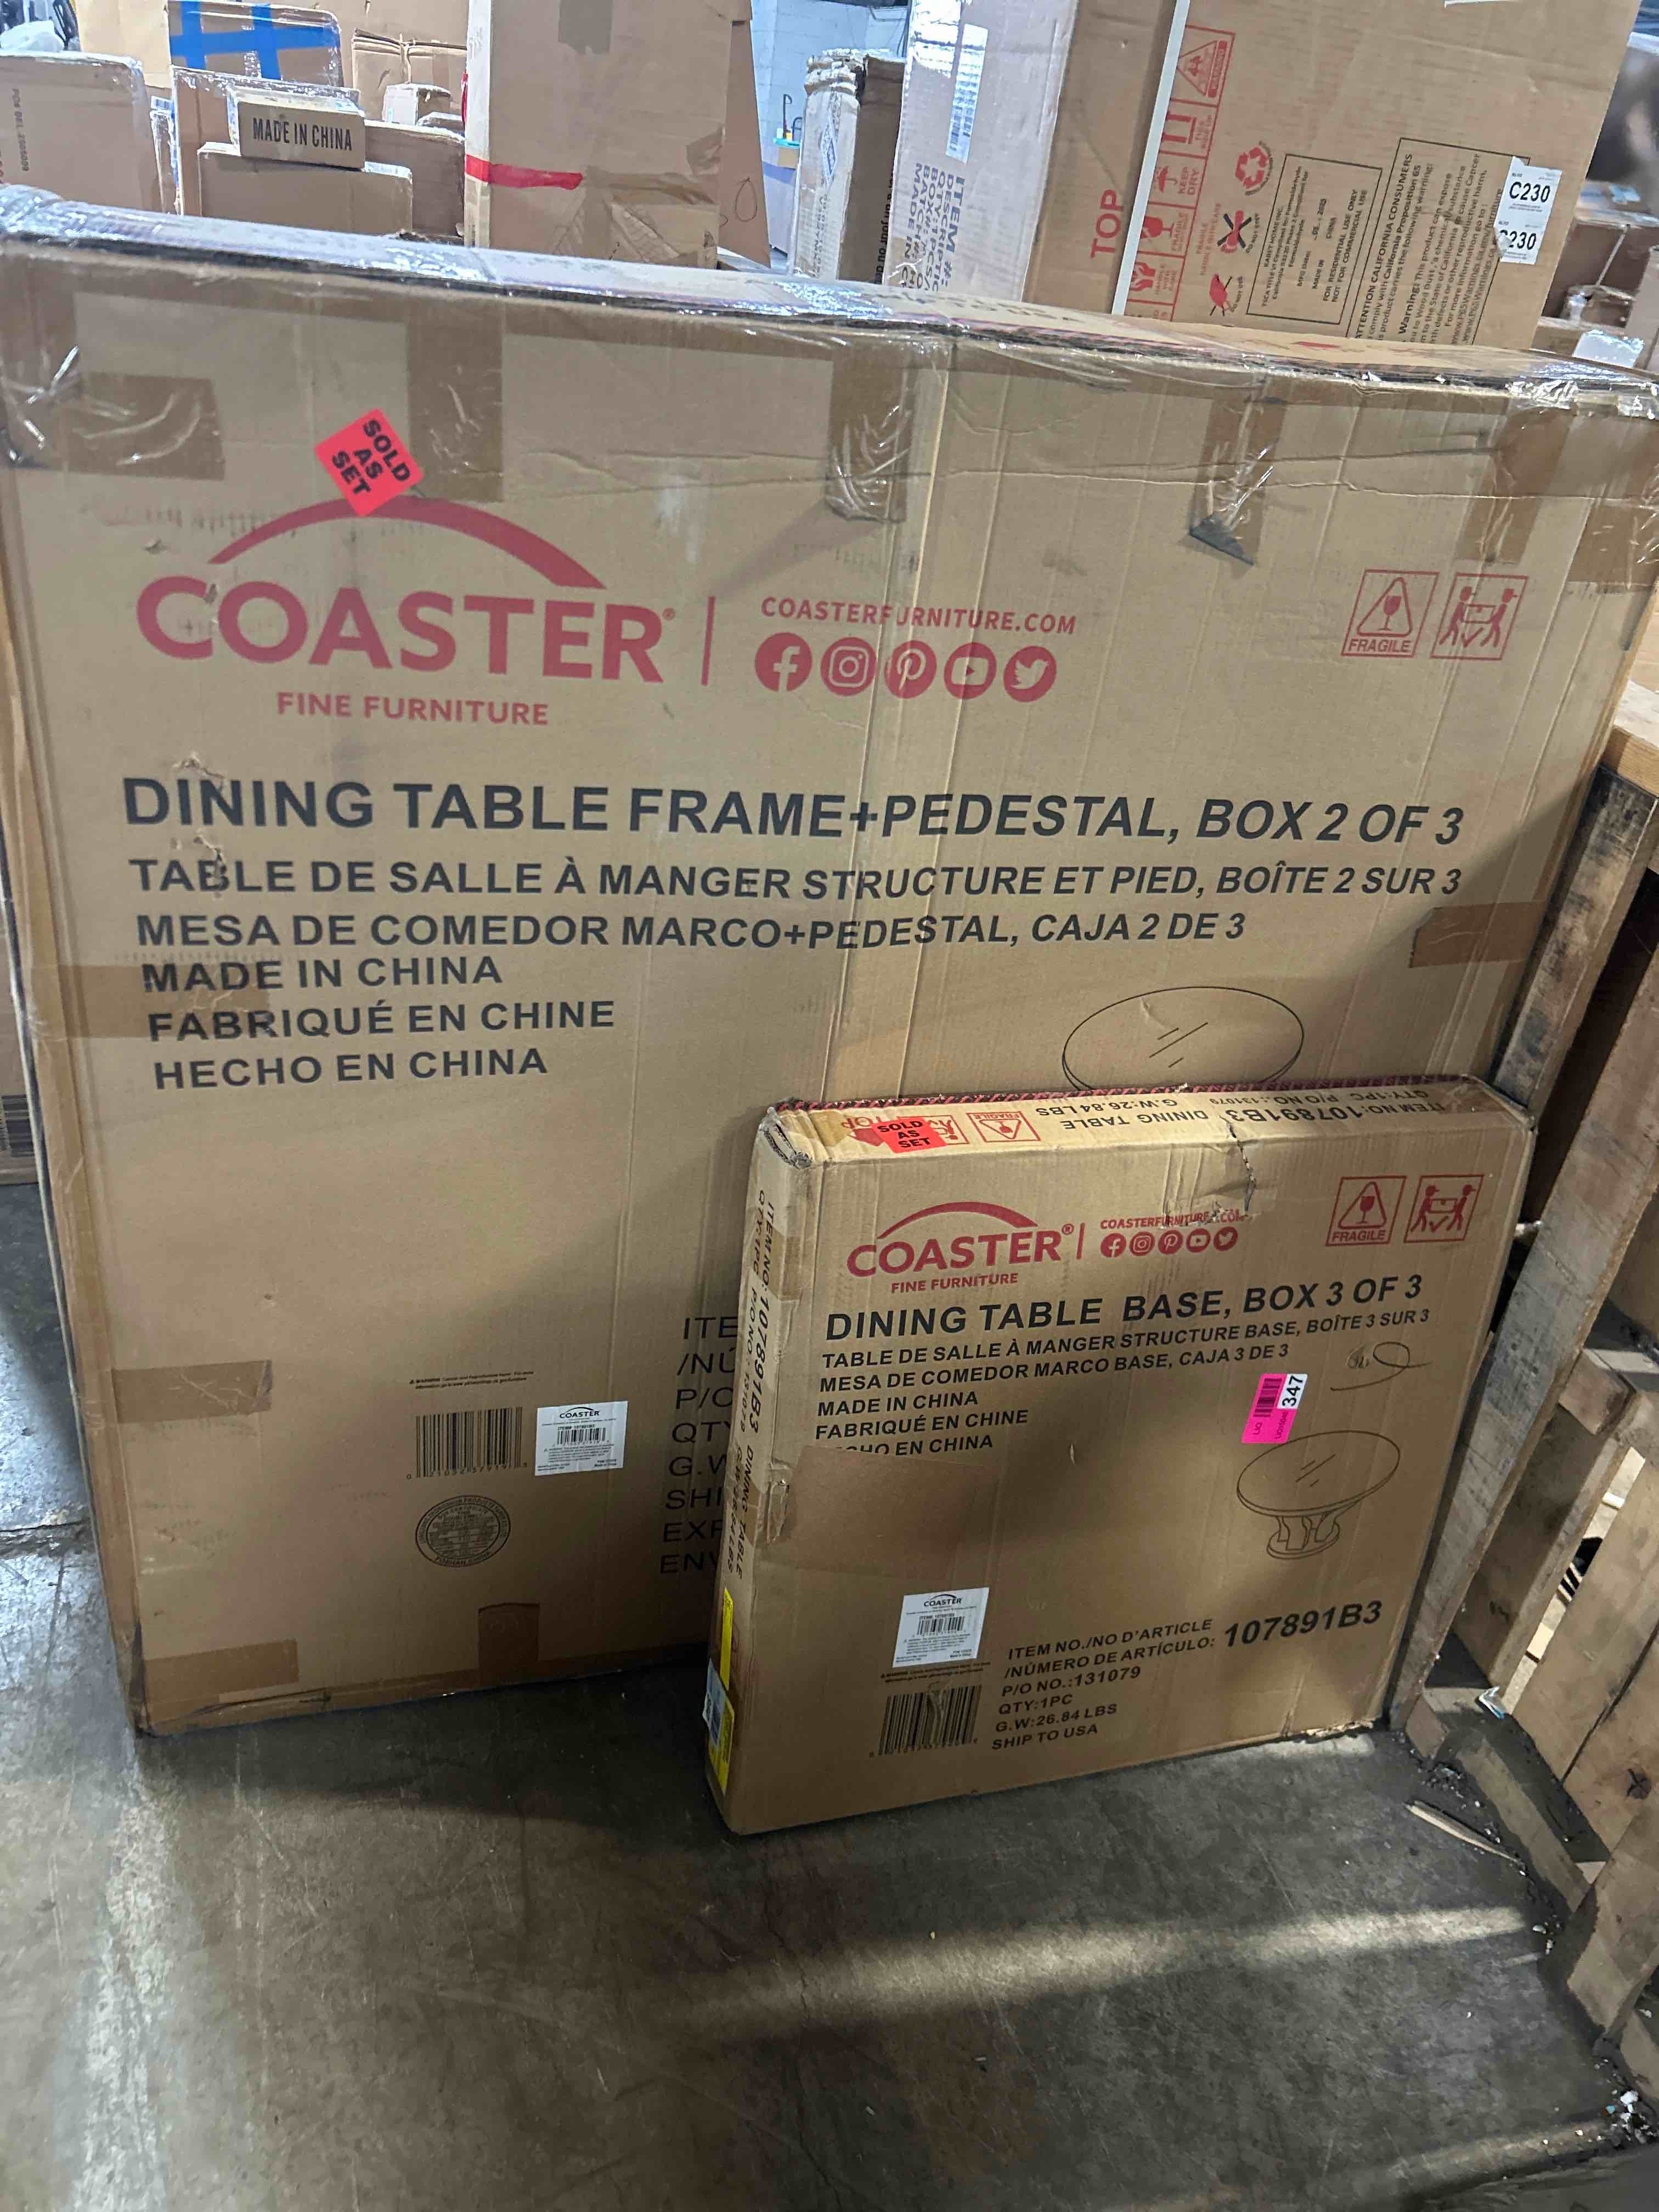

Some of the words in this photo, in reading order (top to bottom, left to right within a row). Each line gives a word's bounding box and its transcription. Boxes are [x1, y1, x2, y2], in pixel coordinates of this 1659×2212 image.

[253, 118, 290, 143] MADE
[295, 123, 307, 145] IN
[312, 125, 352, 151] CHINA
[908, 163, 923, 228] MADE
[1395, 179, 1419, 234] Proposition
[1509, 182, 1550, 202] C230
[947, 177, 965, 252] ITEM
[1091, 189, 1124, 259] TOP
[1369, 222, 1395, 283] CALIFORNIA
[1387, 153, 1414, 221] CONSUMERS
[924, 172, 945, 290] QTY:1PCS/
[1398, 282, 1420, 334] Warning:
[353, 449, 384, 479] AS
[364, 419, 410, 481] SOLD
[332, 449, 370, 494] SET
[762, 596, 1076, 634] COASTERFURNITURE.COM
[1348, 638, 1411, 652] FRAGILE
[277, 692, 351, 716] FINE
[364, 696, 548, 725] FURNITURE
[123, 778, 372, 827] DINING
[393, 783, 608, 830] TABLE
[630, 786, 1179, 845] FRAME+PEDESTAL,
[1197, 799, 1313, 840] BOX
[1316, 803, 1348, 840] 2
[1359, 804, 1430, 842] OF
[1436, 808, 1464, 844] 3
[128, 859, 295, 891] TABLE
[311, 861, 375, 892] DE
[390, 861, 541, 893] SALLE
[554, 856, 586, 894] À
[600, 865, 790, 899] MANGER
[803, 864, 1045, 901] STRUCTURE
[1054, 866, 1108, 894] ET
[1110, 867, 1204, 899] PIED,
[1216, 860, 1329, 893] BOÎTE
[1333, 867, 1355, 893] 2
[1362, 867, 1435, 894] SUR
[1442, 869, 1462, 894] 3
[138, 915, 281, 946] MESA
[293, 915, 356, 945] DE
[371, 915, 609, 945] COMEDOR
[623, 915, 1019, 950] MARCO+PEDESTAL,
[1032, 914, 1129, 941] CAJA
[1138, 913, 1160, 939] 2
[1167, 913, 1218, 939] DE
[1226, 913, 1245, 938] 3
[142, 961, 284, 993] MADE
[298, 960, 341, 988] IN
[358, 956, 503, 986] CHINA
[148, 1000, 393, 1041] FABRIQUÉ
[409, 1005, 465, 1032] EN
[481, 1001, 614, 1030] CHINE
[155, 1056, 321, 1089] HECHO
[336, 1053, 394, 1081] EN
[410, 1048, 548, 1078] CHINA
[1036, 1106, 1077, 1116] LBS
[1079, 1099, 1177, 1109] G.W:26.84
[1209, 1096, 1312, 1105] NO.:131079
[1317, 1094, 1339, 1103] P/O
[1408, 1103, 1446, 1111] ITEM
[877, 1121, 923, 1132] SOLD
[1060, 1116, 1130, 1129] TABLE
[1137, 1110, 1208, 1123] DINING
[898, 1130, 920, 1139] AS
[898, 1137, 930, 1148] SET
[765, 1201, 774, 1254] ITEM
[1332, 1230, 1386, 1242] FRAGILE
[891, 1280, 926, 1294] FINE
[931, 1273, 1018, 1290] FURNITURE
[826, 1307, 966, 1340] DINING
[979, 1299, 1102, 1330] TABLE
[1122, 1290, 1230, 1322] BASE,
[1243, 1283, 1319, 1312] BOX
[1326, 1282, 1343, 1306] 3
[1353, 1276, 1398, 1304] OF
[1406, 1274, 1421, 1299] 3
[822, 1350, 893, 1368] TABLE
[899, 1348, 927, 1363] DE
[933, 1343, 1001, 1361] SALLE
[1006, 1339, 1020, 1356] À
[1026, 1336, 1115, 1355] MANGER
[1120, 1325, 1240, 1348] STRUCTURE
[1245, 1321, 1301, 1339] BASE,
[1306, 1314, 1362, 1333] BOÎTE
[1365, 1314, 1375, 1328] 3
[1380, 1311, 1413, 1326] SUR
[1420, 1309, 1430, 1322] 3
[820, 1375, 881, 1392] MESA
[888, 1372, 916, 1387] DE
[922, 1364, 1028, 1385] COMEDOR
[1035, 1359, 1109, 1377] MARCO
[1114, 1354, 1172, 1370] BASE,
[1180, 1348, 1229, 1365] CAJA
[1234, 1347, 1244, 1361] 3
[1249, 1345, 1275, 1359] DE
[1279, 1344, 1288, 1357] 3
[818, 1398, 880, 1416] MADE
[887, 1397, 906, 1411] IN
[913, 1391, 978, 1409] CHINA
[1282, 1375, 1302, 1406] 347
[673, 1421, 730, 1444] QT
[816, 1414, 926, 1440] FABRIQUÉ
[932, 1415, 959, 1430] EN
[966, 1410, 1029, 1427] CHINE
[896, 1441, 923, 1455] EN
[929, 1435, 993, 1452] CHINA
[742, 1445, 753, 1513] DINING
[661, 1551, 718, 1573] EN
[924, 1598, 961, 1607] COASTER
[1004, 1656, 1090, 1678] /NÚMERO
[1094, 1652, 1118, 1664] DE
[1120, 1637, 1215, 1661] ARTÍCULO:
[1225, 1600, 1382, 1647] 107891B3
[1008, 1643, 1051, 1660] ITEM
[1055, 1634, 1117, 1653] NO./NO
[1121, 1620, 1212, 1643] D'ARTICLE
[1002, 1683, 1031, 1697] P/O
[1037, 1666, 1140, 1692] NO.:131079
[996, 1709, 1080, 1732] G.W:26.84
[1084, 1703, 1117, 1718] LBS
[998, 1694, 1073, 1714] QTY:1PC
[992, 1735, 1032, 1750] SHIP
[1037, 1730, 1059, 1742] TO
[1064, 1724, 1097, 1738] USA
